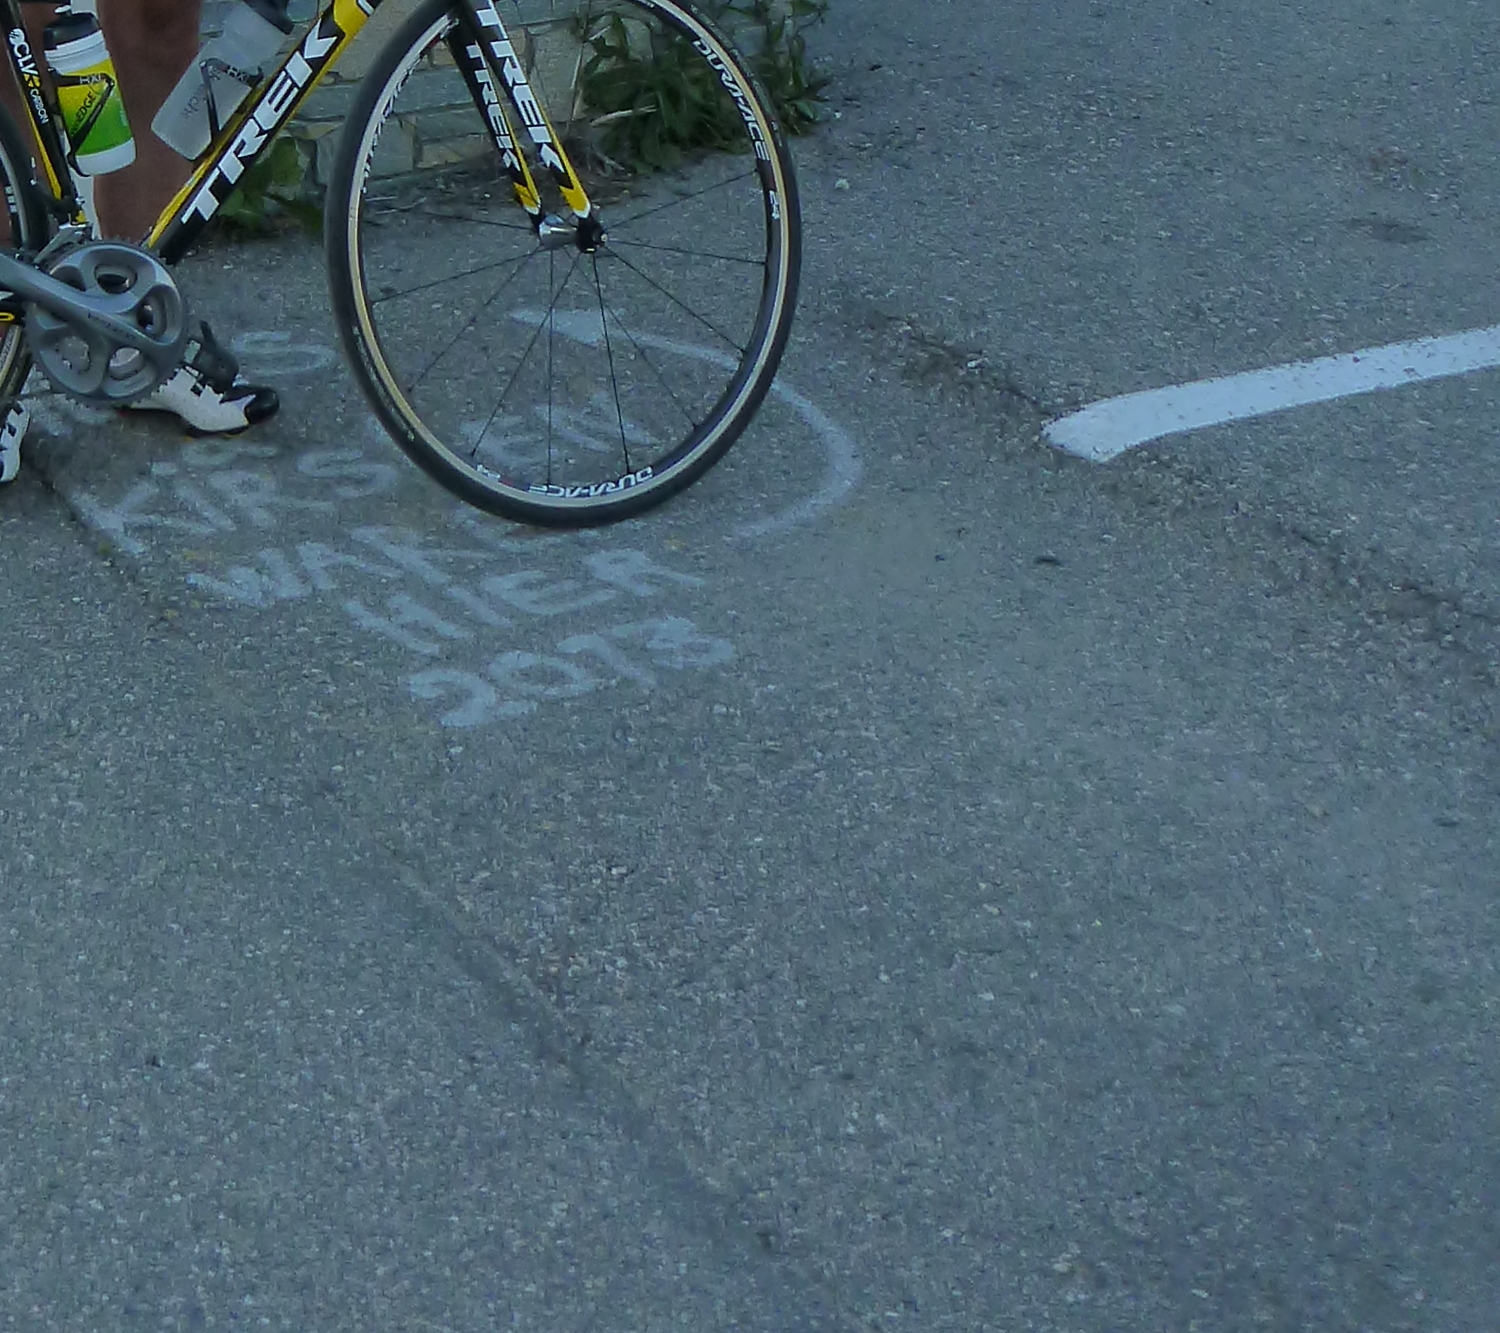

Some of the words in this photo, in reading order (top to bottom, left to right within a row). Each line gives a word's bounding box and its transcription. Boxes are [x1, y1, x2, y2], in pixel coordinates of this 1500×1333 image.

[180, 17, 338, 225] TREK
[465, 38, 521, 171] TREK
[692, 39, 772, 162] DURA-ACE
[527, 465, 656, 499] DURA-ACE
[408, 615, 736, 729] 2013
